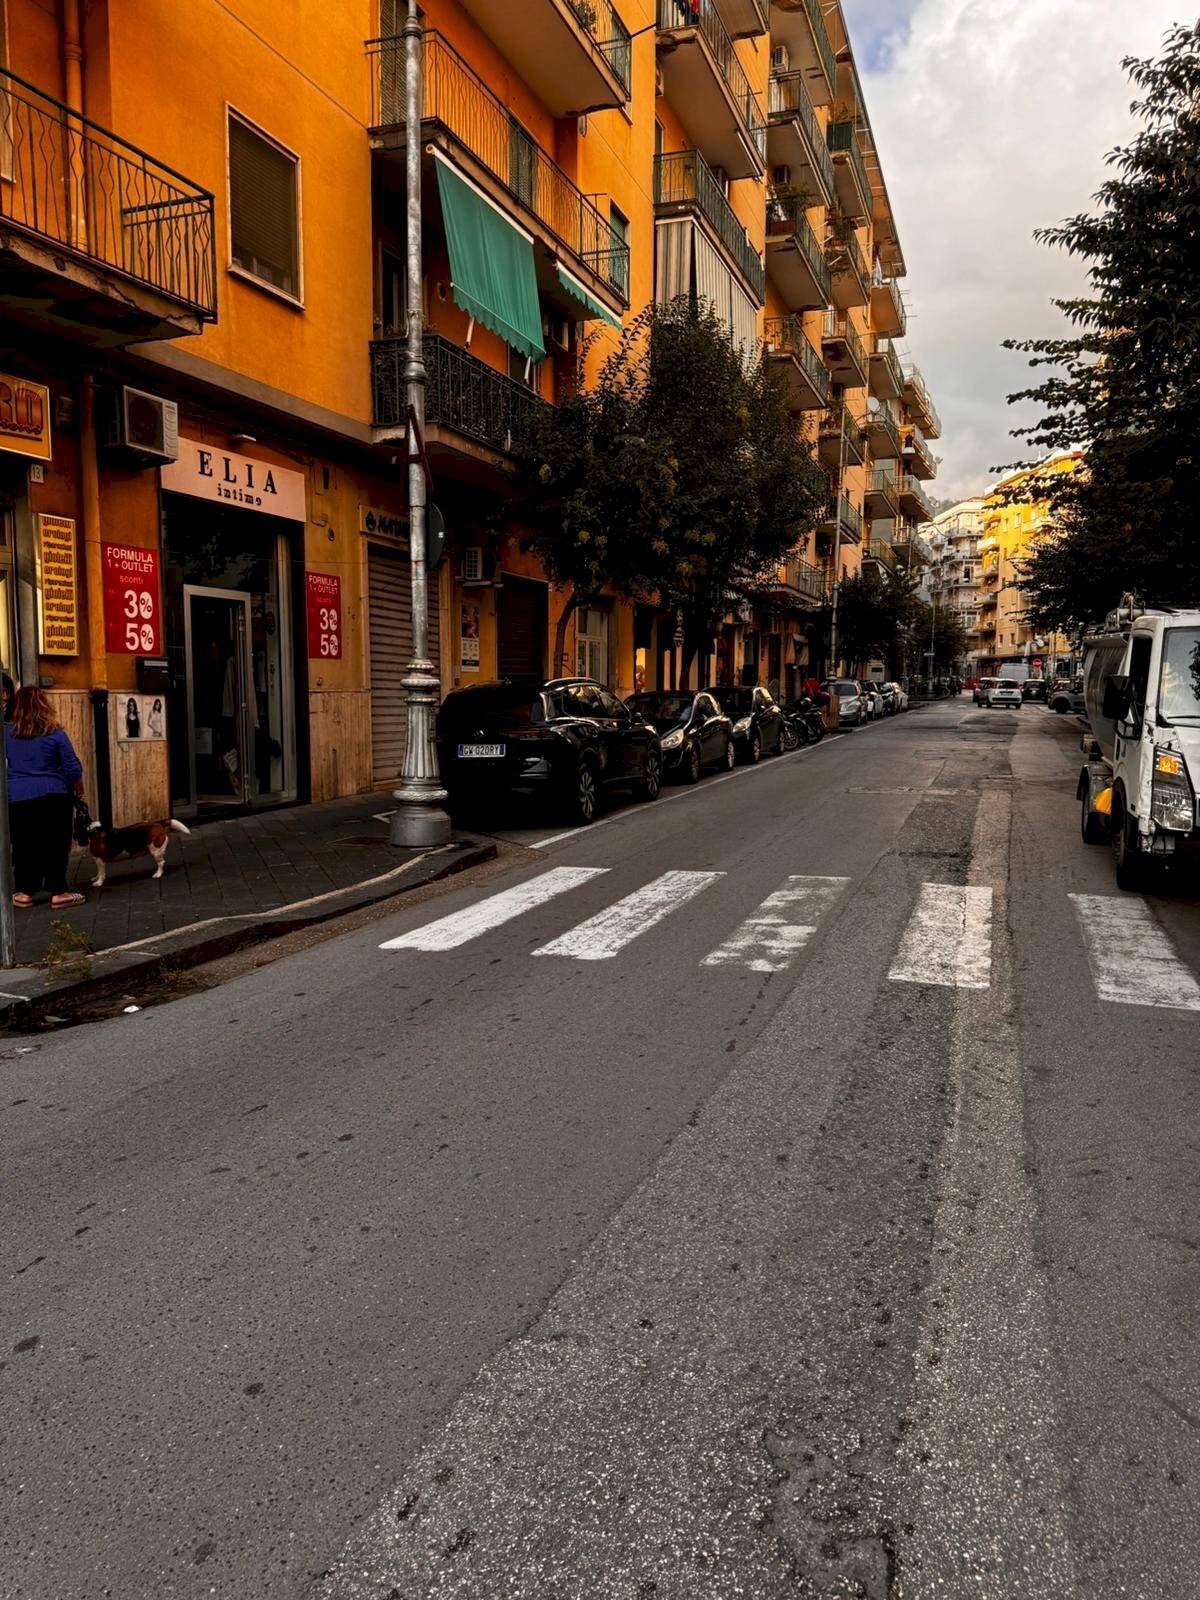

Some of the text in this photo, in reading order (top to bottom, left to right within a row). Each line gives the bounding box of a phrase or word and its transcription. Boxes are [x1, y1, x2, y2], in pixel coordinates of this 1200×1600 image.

[32, 467, 41, 480] 13
[197, 449, 277, 494] ELIA
[217, 483, 262, 506] intimo
[107, 547, 154, 563] FORMULA
[107, 559, 112, 568] 1
[121, 560, 154, 573] OUTLET
[120, 576, 143, 584] sconti
[308, 575, 338, 587] FORMULA
[317, 585, 338, 595] OUTLET
